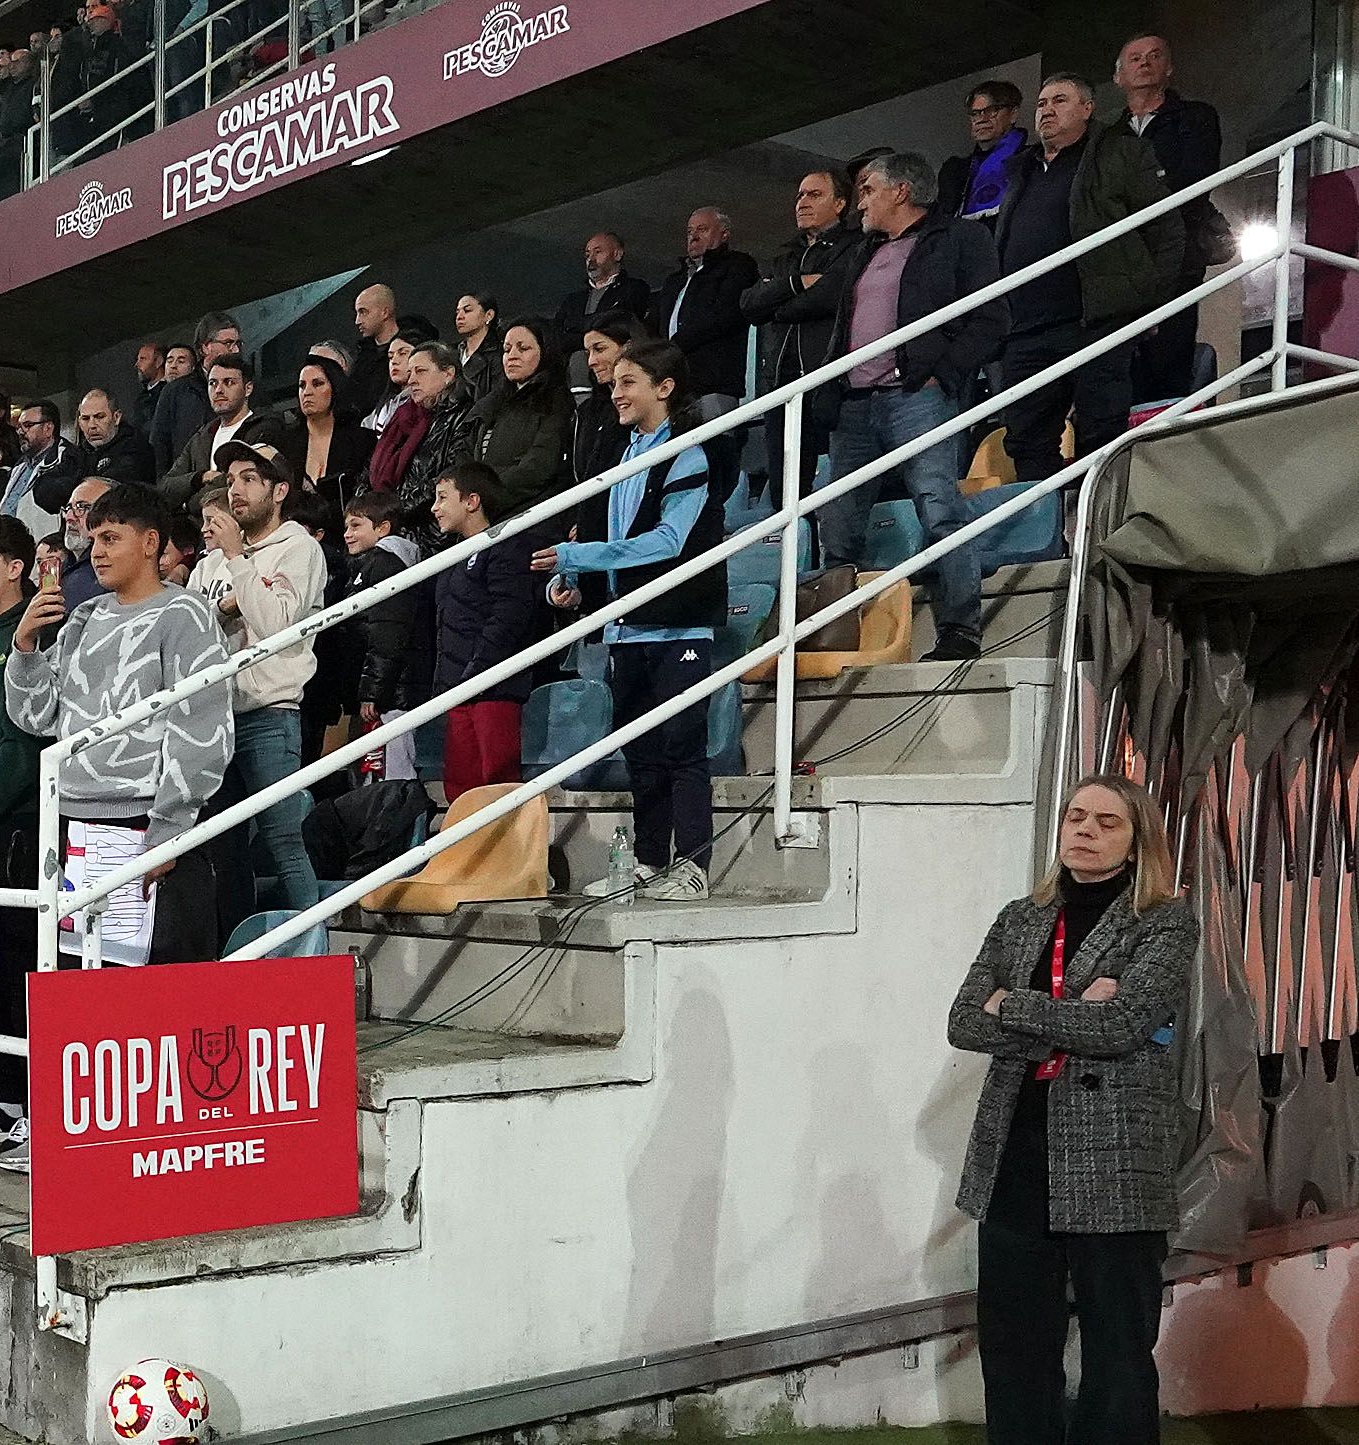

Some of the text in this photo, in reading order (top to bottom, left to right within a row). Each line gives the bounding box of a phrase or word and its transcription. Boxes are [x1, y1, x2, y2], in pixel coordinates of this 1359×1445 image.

[443, 4, 571, 81] PESCAMAR
[482, 1, 521, 26] CONSERVAS
[217, 63, 337, 137] CONSERVAS
[162, 75, 400, 220] PESCAMAR
[55, 187, 134, 238] PESCAMAR
[62, 1023, 326, 1135] COPA DEL REY
[132, 1138, 265, 1178] MAPFRE
